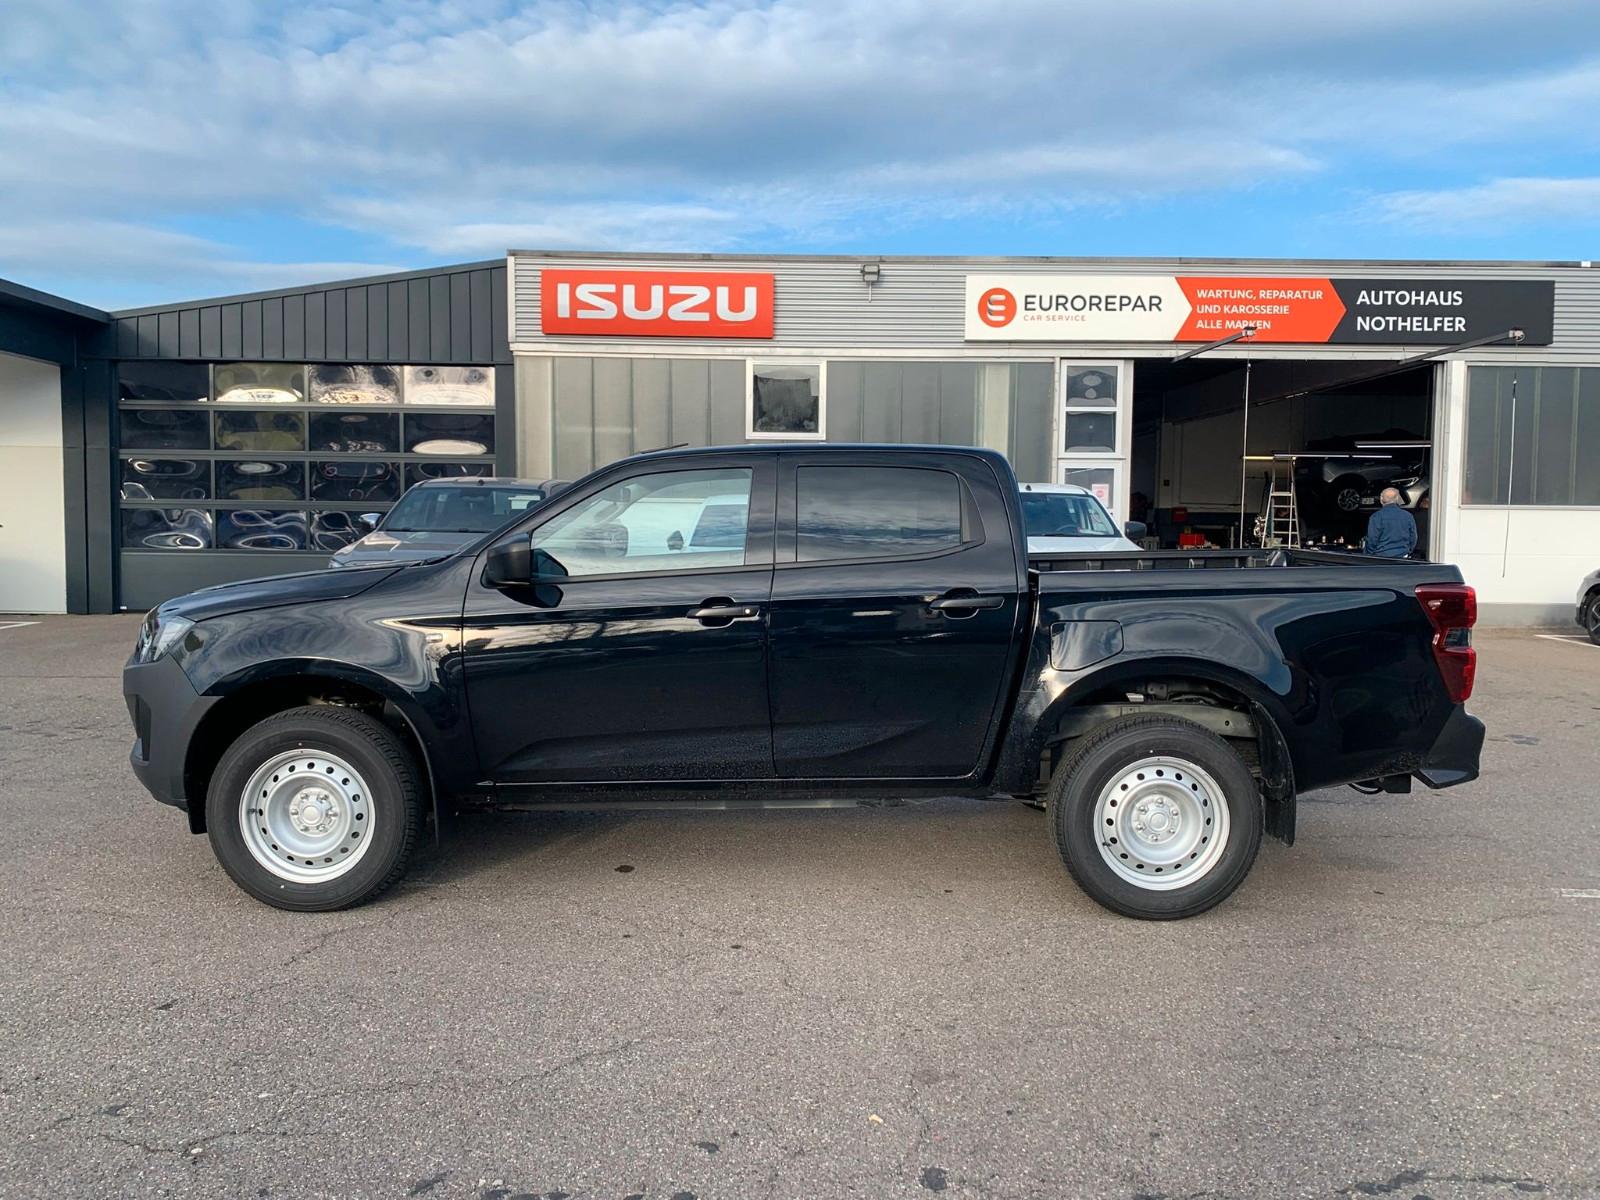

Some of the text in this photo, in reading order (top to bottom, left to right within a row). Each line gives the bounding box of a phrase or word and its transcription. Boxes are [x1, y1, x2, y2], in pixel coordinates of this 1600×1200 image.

[1196, 289, 1323, 300] WARTUNG, REPARATUR
[1356, 290, 1463, 306] AUTOHAUS
[557, 283, 758, 323] ISUZU
[1024, 295, 1163, 312] EUROREPAR
[1196, 305, 1290, 314] UND KAROSSERIE
[1023, 314, 1043, 322] CAR
[1196, 320, 1222, 329] ALLE
[1356, 316, 1467, 331] NOTHELFER
